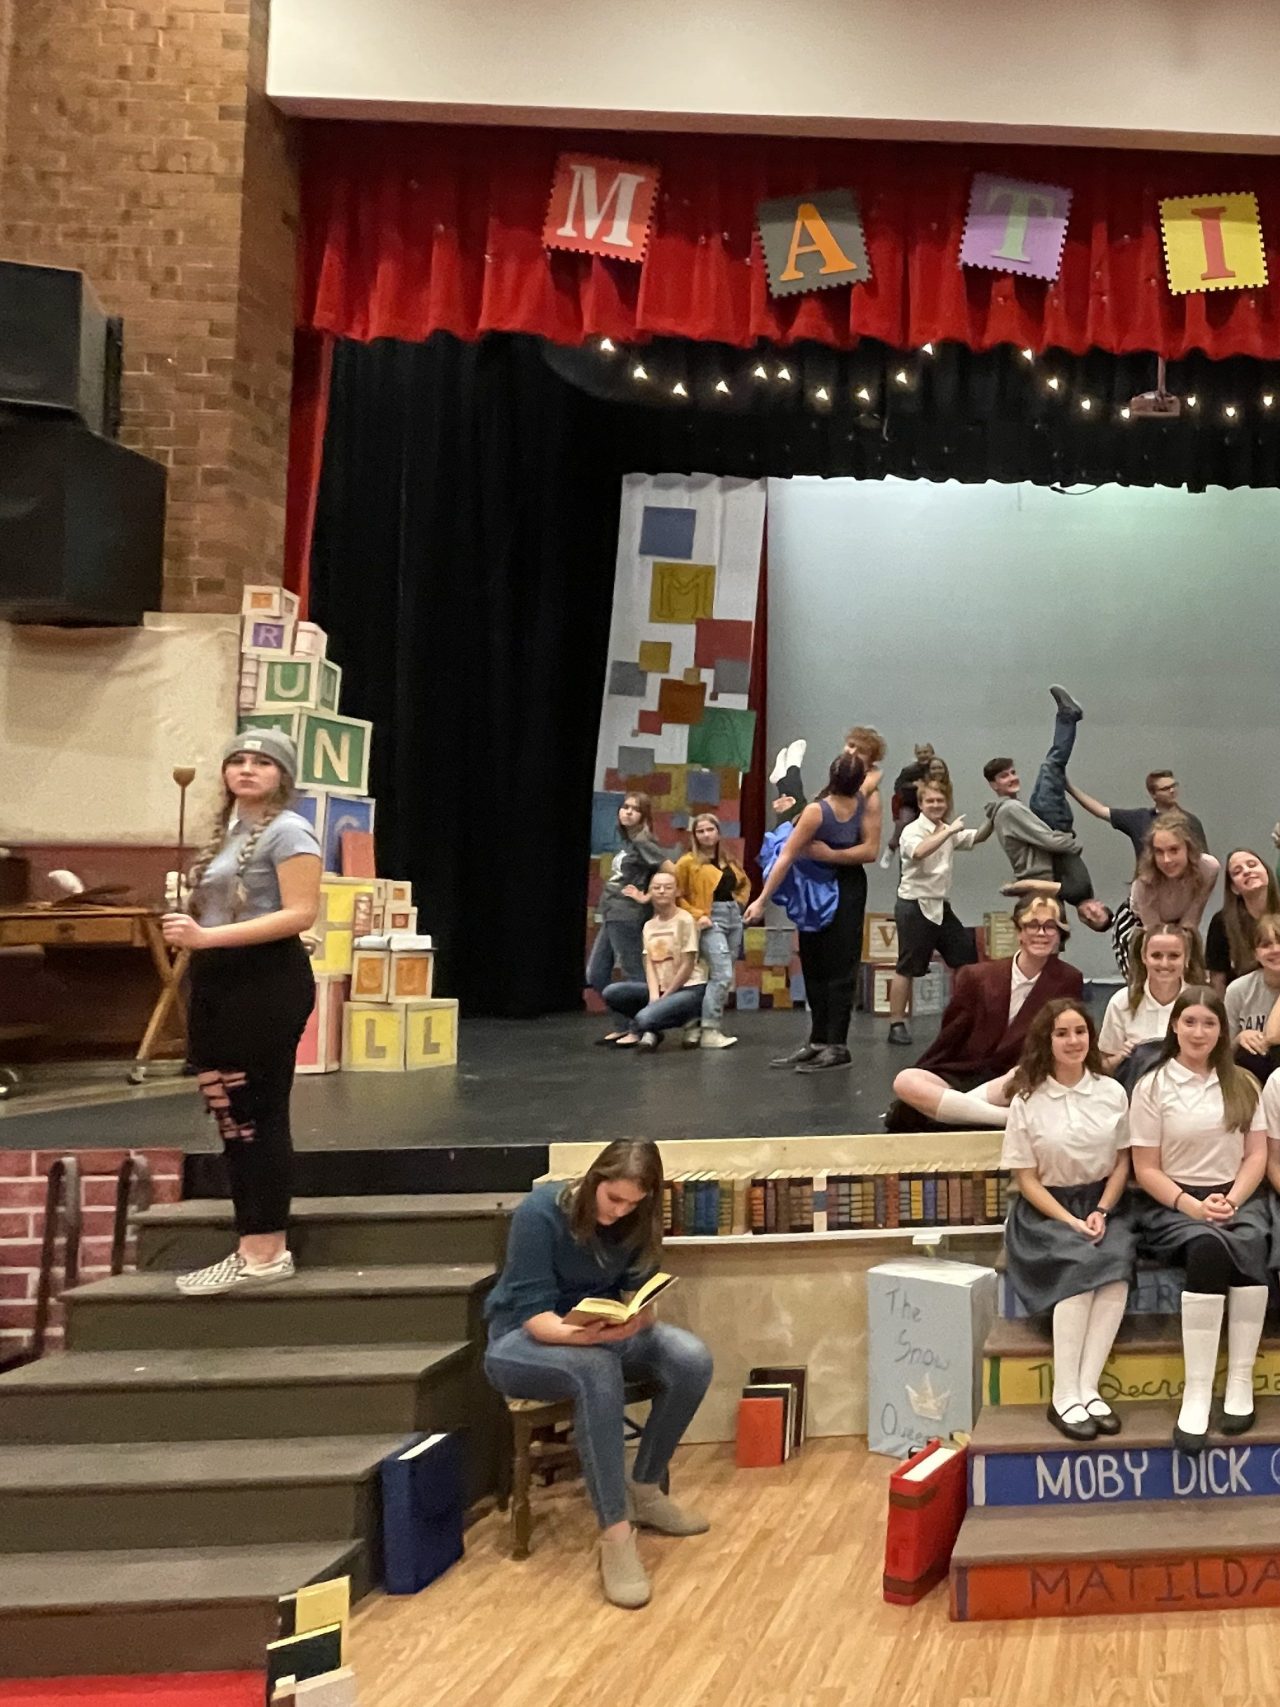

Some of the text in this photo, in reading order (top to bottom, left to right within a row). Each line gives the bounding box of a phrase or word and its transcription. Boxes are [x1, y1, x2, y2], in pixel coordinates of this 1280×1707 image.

[259, 626, 278, 647] R
[274, 664, 305, 698] U
[314, 732, 350, 782] N
[365, 1018, 387, 1059] L
[422, 1016, 441, 1055] L
[886, 1288, 922, 1323] The
[895, 1329, 949, 1370] Snow
[1036, 1446, 1251, 1500] MOBY DICK
